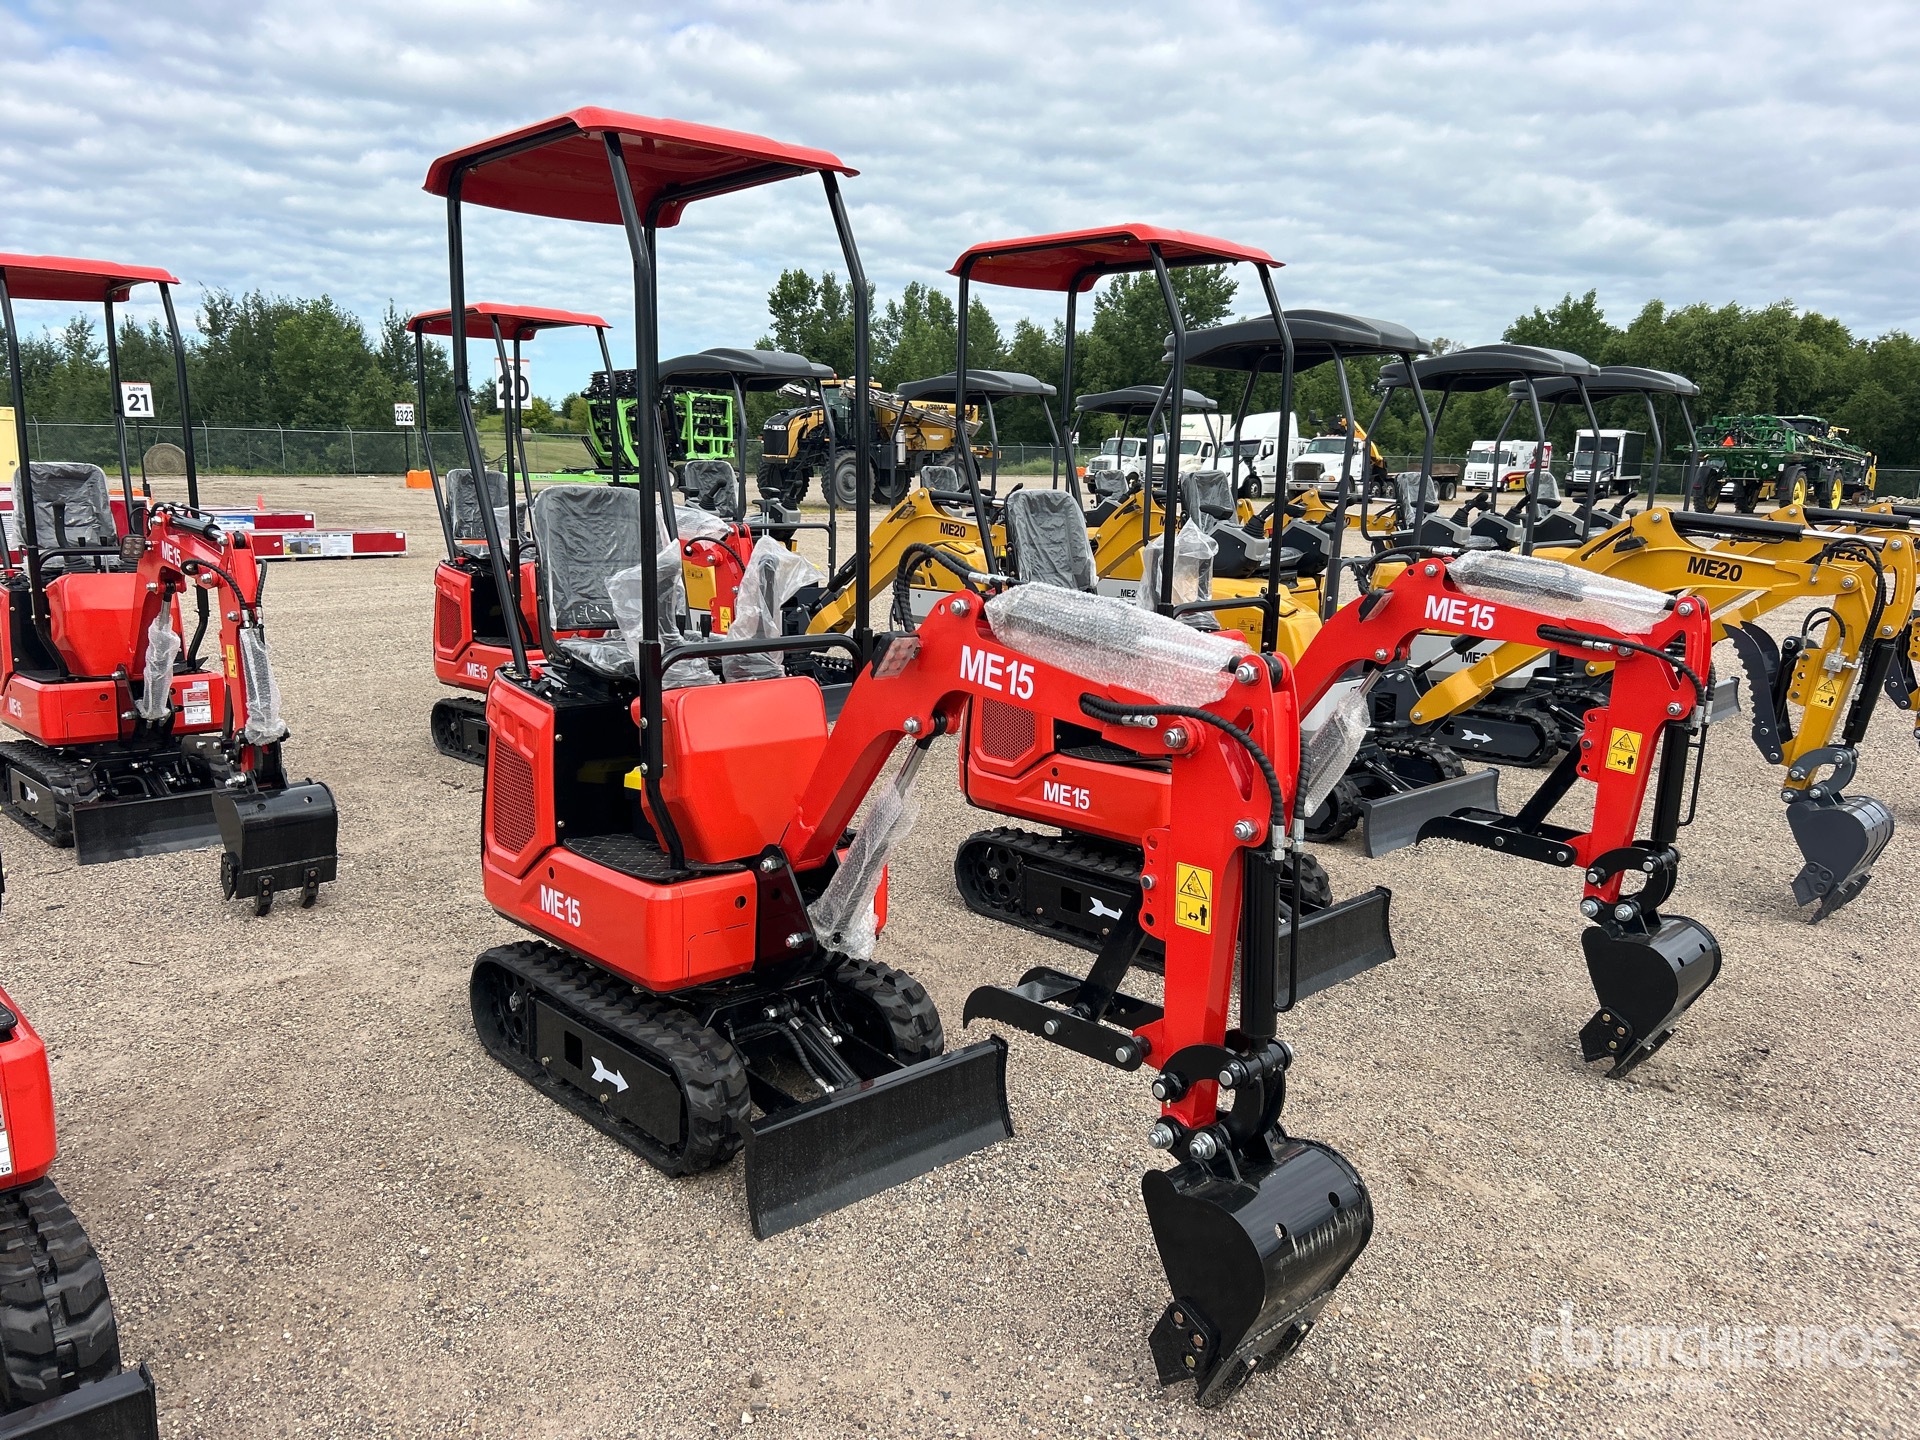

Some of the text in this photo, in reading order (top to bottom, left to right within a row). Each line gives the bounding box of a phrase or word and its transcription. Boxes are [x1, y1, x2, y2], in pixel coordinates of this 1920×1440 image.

[127, 393, 150, 412] 21
[395, 410, 404, 422] 23
[403, 410, 414, 422] 23
[939, 522, 966, 538] ME20
[161, 539, 182, 568] ME15
[1687, 556, 1743, 582] ME20
[1120, 588, 1137, 598] ME2
[1424, 594, 1495, 631] ME15
[466, 662, 488, 680] ME15
[959, 644, 1035, 700] ME15
[1043, 780, 1091, 810] ME15
[540, 883, 582, 928] ME15
